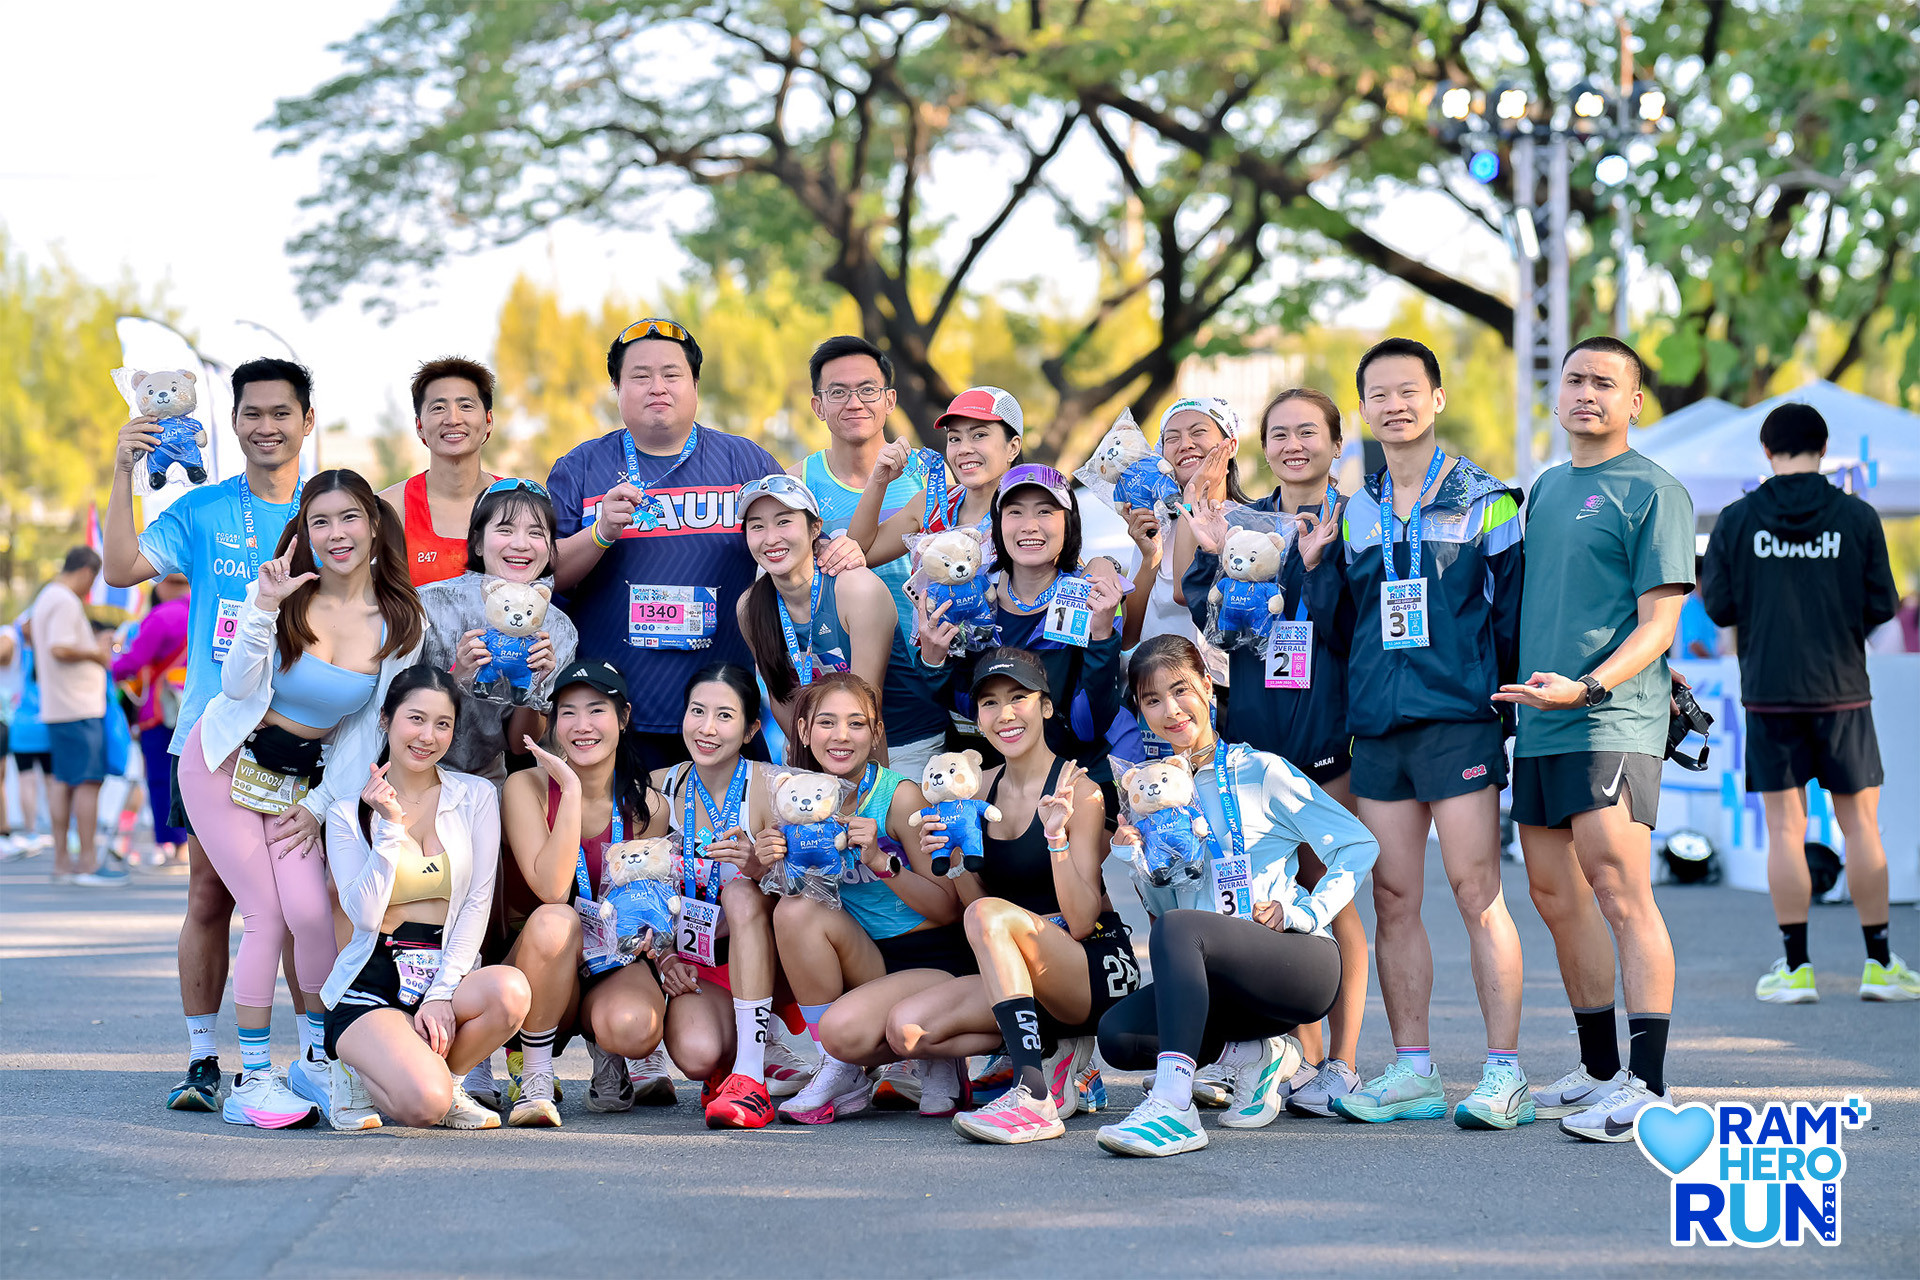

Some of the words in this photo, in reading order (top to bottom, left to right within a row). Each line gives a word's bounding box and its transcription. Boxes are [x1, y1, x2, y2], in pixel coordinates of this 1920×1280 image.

[627, 453, 637, 471] RUN
[1428, 460, 1440, 478] 2026
[928, 472, 938, 495] RAM
[241, 485, 252, 509] 2026
[244, 511, 255, 533] RUN
[1411, 529, 1419, 550] RAM
[1754, 529, 1841, 559] COACH
[417, 551, 437, 563] 247
[213, 557, 251, 579] COA
[1061, 587, 1076, 596] RUN
[222, 609, 238, 617] RUN
[639, 604, 678, 619] 1340
[704, 602, 716, 611] 10
[1055, 606, 1067, 631] 1
[1389, 612, 1406, 637] 3
[784, 626, 797, 648] RUN
[834, 661, 848, 671] 10
[1273, 652, 1290, 677] 2
[240, 765, 255, 777] VIP
[256, 771, 284, 788] 10024
[1218, 765, 1227, 783] RUN
[721, 800, 732, 818] RUN
[727, 779, 740, 802] 2026
[1223, 796, 1234, 816] HERO
[685, 836, 693, 855] RAM
[800, 839, 818, 848] RAM
[1219, 869, 1233, 878] RUN
[1218, 880, 1248, 891] OVERALL
[1221, 890, 1237, 916] 3
[686, 909, 700, 918] RUN
[683, 928, 698, 954] 2
[755, 1006, 771, 1044] 247
[1015, 1010, 1042, 1050] 247
[1175, 1065, 1191, 1077] FILA
